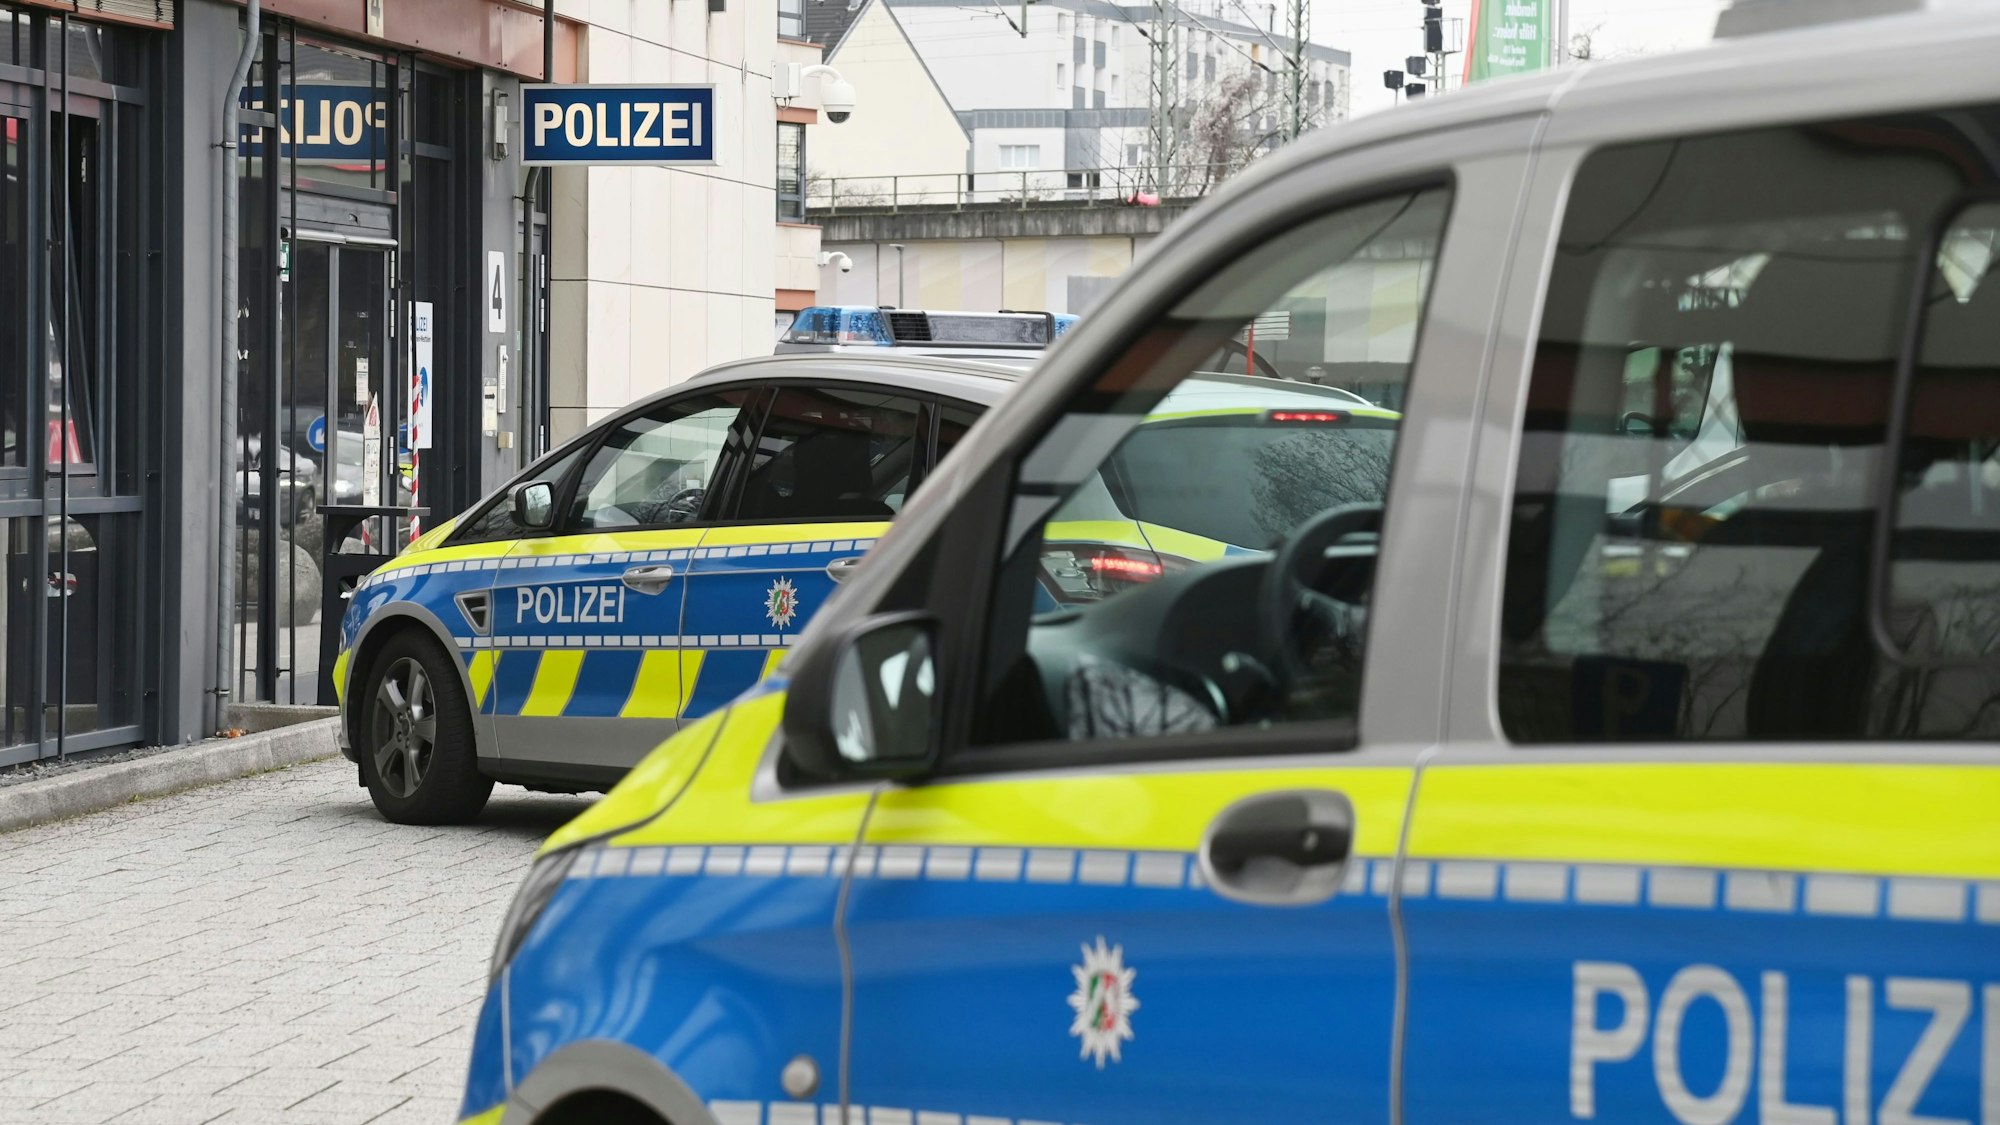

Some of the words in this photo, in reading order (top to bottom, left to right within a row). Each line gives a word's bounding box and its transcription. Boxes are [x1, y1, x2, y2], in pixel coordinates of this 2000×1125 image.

[534, 102, 702, 147] POLIZEI
[492, 264, 503, 320] 4
[516, 586, 625, 624] POLIZEI
